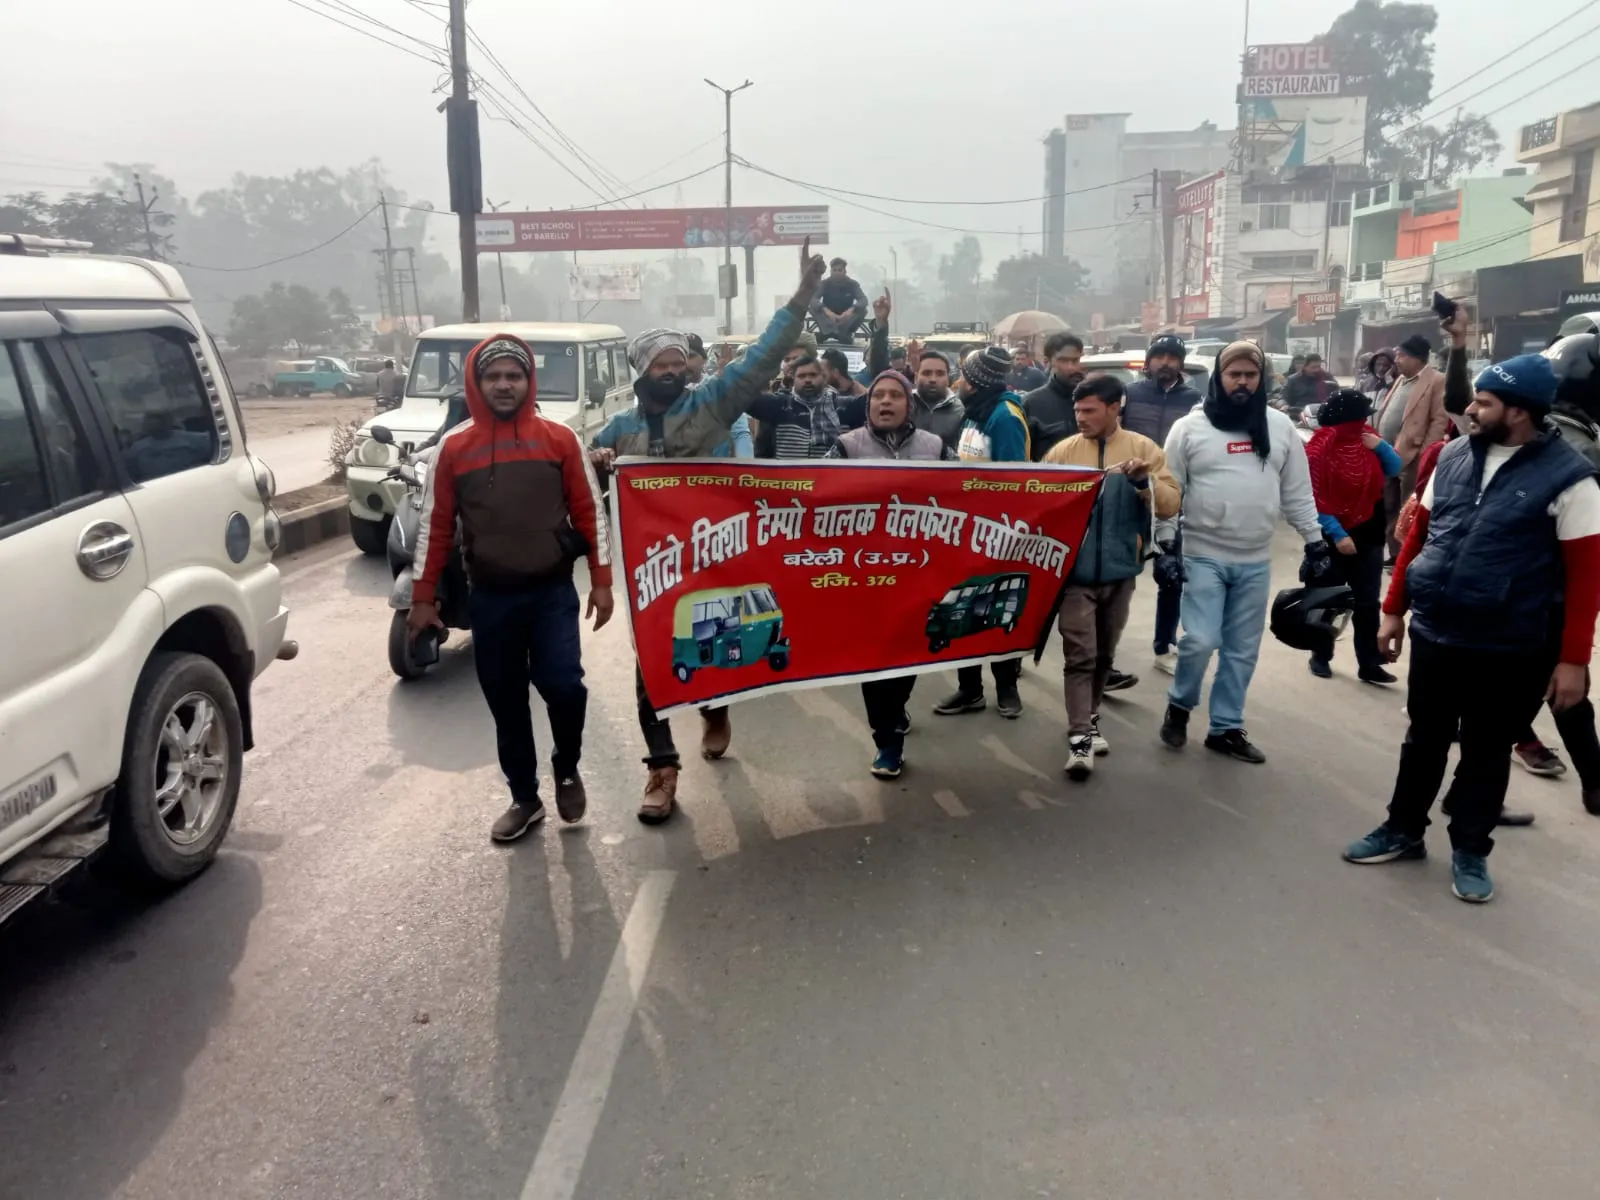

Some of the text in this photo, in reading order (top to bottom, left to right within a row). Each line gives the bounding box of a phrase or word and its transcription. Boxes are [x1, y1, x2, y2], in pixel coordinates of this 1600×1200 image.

[1258, 45, 1330, 71] HOTEL
[1247, 75, 1338, 95] RESTAURANT
[1178, 183, 1213, 209] SATELLITE
[521, 222, 539, 230] BEST
[541, 221, 575, 230] SCHOOL
[521, 232, 532, 240] OF
[630, 475, 681, 490] चालक
[686, 475, 733, 487] एकता
[634, 534, 684, 611] ऑटो
[691, 516, 750, 574] रिक्शा
[813, 503, 881, 538] चालक
[885, 494, 968, 547] वेलफेयर
[783, 547, 845, 566] बरेली
[810, 572, 896, 589] रजि. 376
